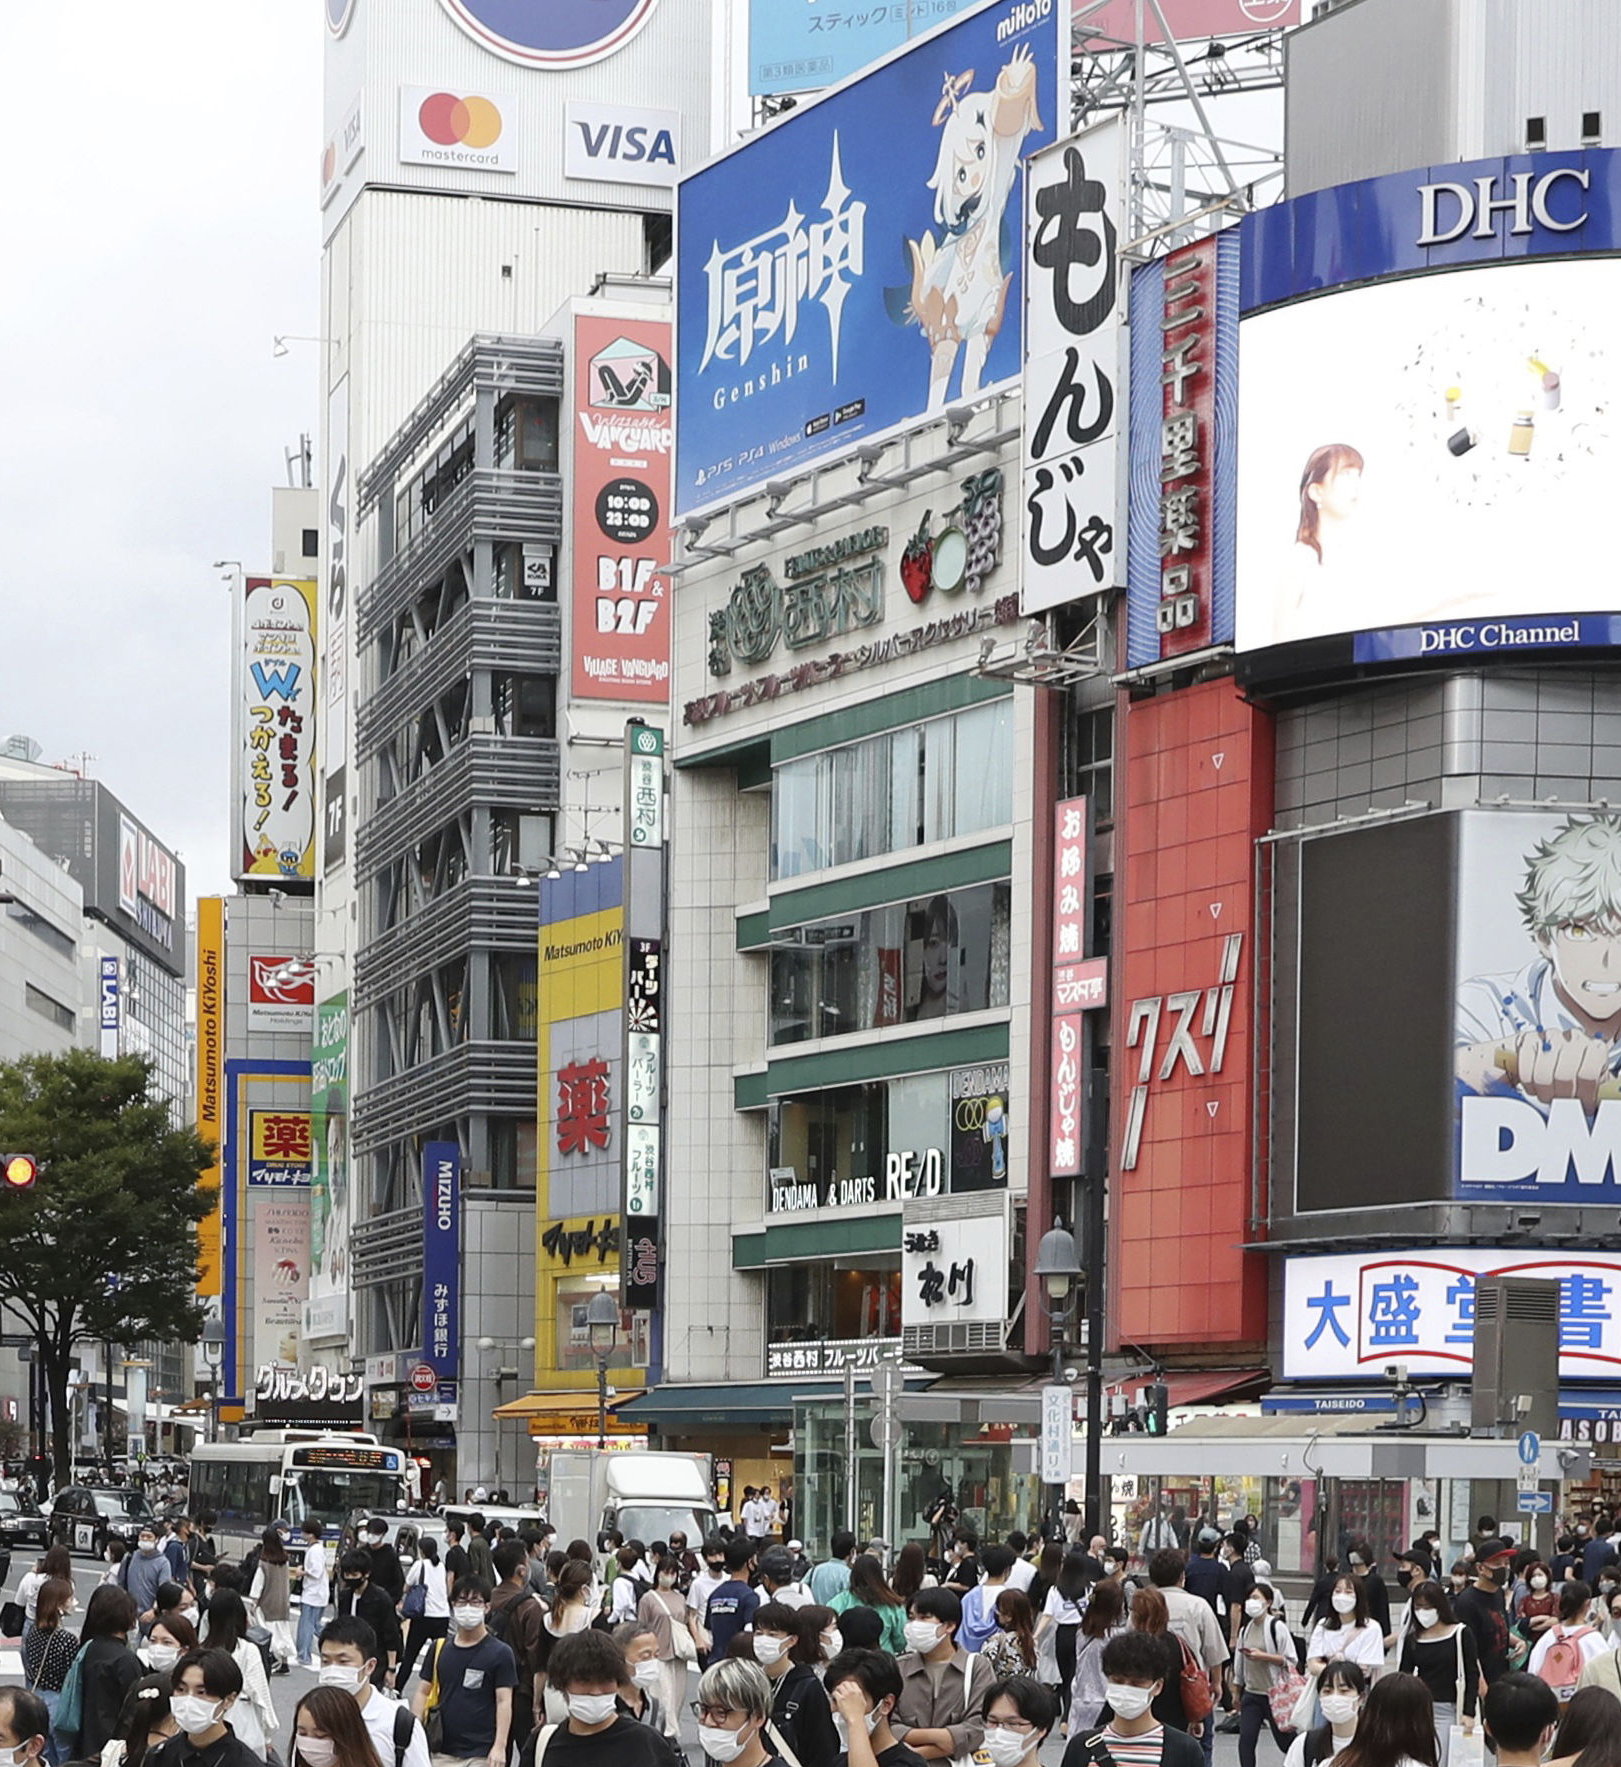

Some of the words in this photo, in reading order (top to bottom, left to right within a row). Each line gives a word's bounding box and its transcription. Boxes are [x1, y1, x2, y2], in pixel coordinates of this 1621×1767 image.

[808, 4, 888, 34] スティック
[422, 149, 499, 165] mastercard
[572, 120, 676, 165] VISA
[1417, 169, 1590, 247] DHC
[698, 128, 868, 386] 原神
[713, 353, 810, 410] Genshin
[1026, 146, 1119, 583] もんじゃ
[579, 411, 672, 453] VANGUARD
[1155, 250, 1206, 635] 三千里薬品
[739, 446, 765, 466] PS4
[530, 587, 544, 596] 7F
[597, 556, 657, 592] B1F
[596, 597, 659, 634] B2F
[1420, 626, 1475, 652] DHC
[1479, 620, 1580, 648] Channel
[329, 797, 343, 837] 7F
[636, 786, 657, 827] 西村
[138, 829, 176, 921] LABI
[1062, 808, 1081, 954] お好み焼
[544, 937, 604, 962] Matsumoto
[604, 928, 625, 949] KiY
[203, 949, 217, 1016] KiYoshi
[645, 954, 658, 996] ダーツ
[102, 979, 116, 1028] LABI
[203, 1021, 217, 1123] Matsumoto
[644, 1051, 656, 1096] フルーツ
[952, 1063, 1011, 1100] DENDAMA
[556, 1057, 611, 1154] 薬
[263, 1115, 311, 1159] 薬
[631, 1150, 642, 1195] フルーツ
[772, 1183, 818, 1212] DENDAMA
[829, 1184, 837, 1206] &
[840, 1176, 875, 1204] DARTS
[887, 1148, 941, 1200] RE/D
[438, 1160, 453, 1231] MIZUHO
[635, 1236, 657, 1286] HUB
[433, 1283, 449, 1359] みずほ銀行
[256, 1361, 365, 1402] グルメタウン
[769, 1350, 819, 1370] 渋谷西村
[1314, 1398, 1366, 1411] TAISEIDO
[1046, 1393, 1060, 1468] 文化村通り
